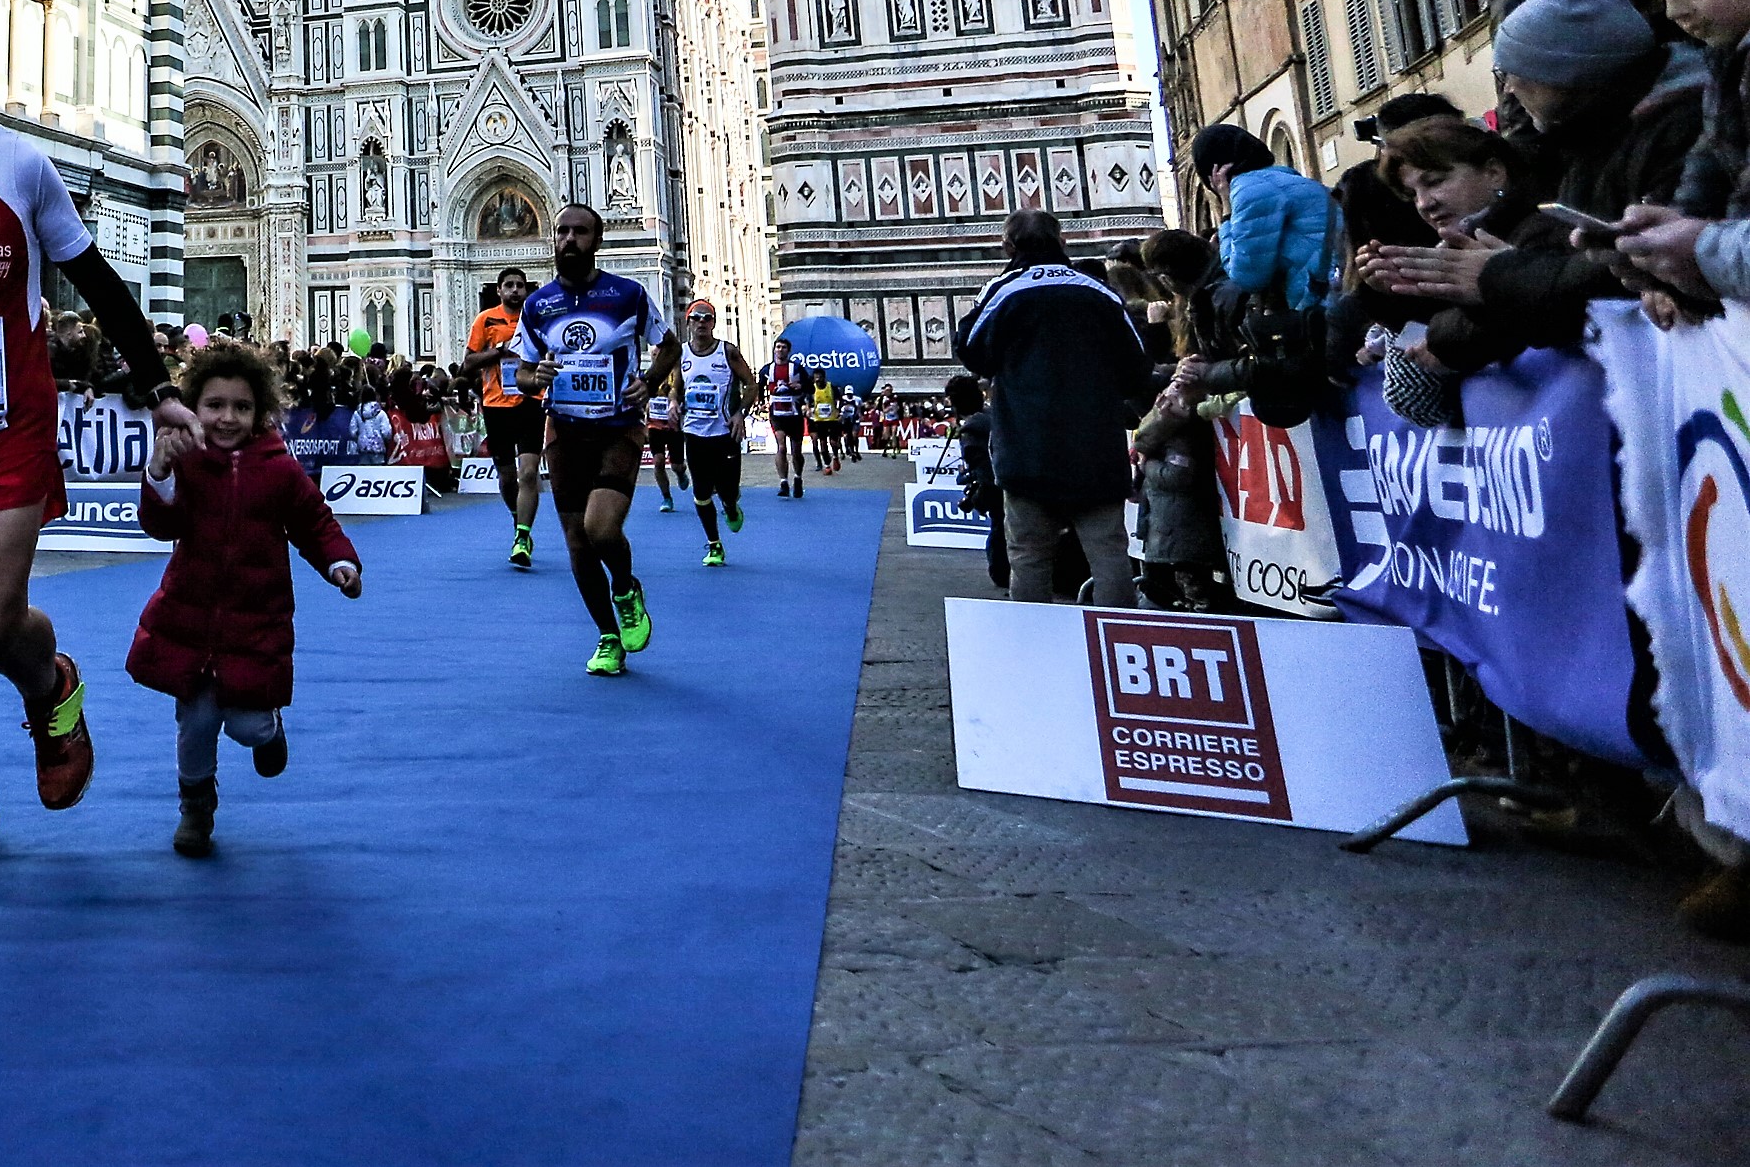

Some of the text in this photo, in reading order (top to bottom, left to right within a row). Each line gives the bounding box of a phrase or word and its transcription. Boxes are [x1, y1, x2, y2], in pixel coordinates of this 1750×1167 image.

[1046, 267, 1077, 278] asics
[571, 374, 608, 392] 5876
[57, 407, 148, 474] etila
[355, 479, 417, 499] asics
[53, 501, 139, 522] unca
[1112, 641, 1229, 703] BRT
[1111, 725, 1262, 758] CORRIERE
[1113, 749, 1266, 782] ESPRESSO
